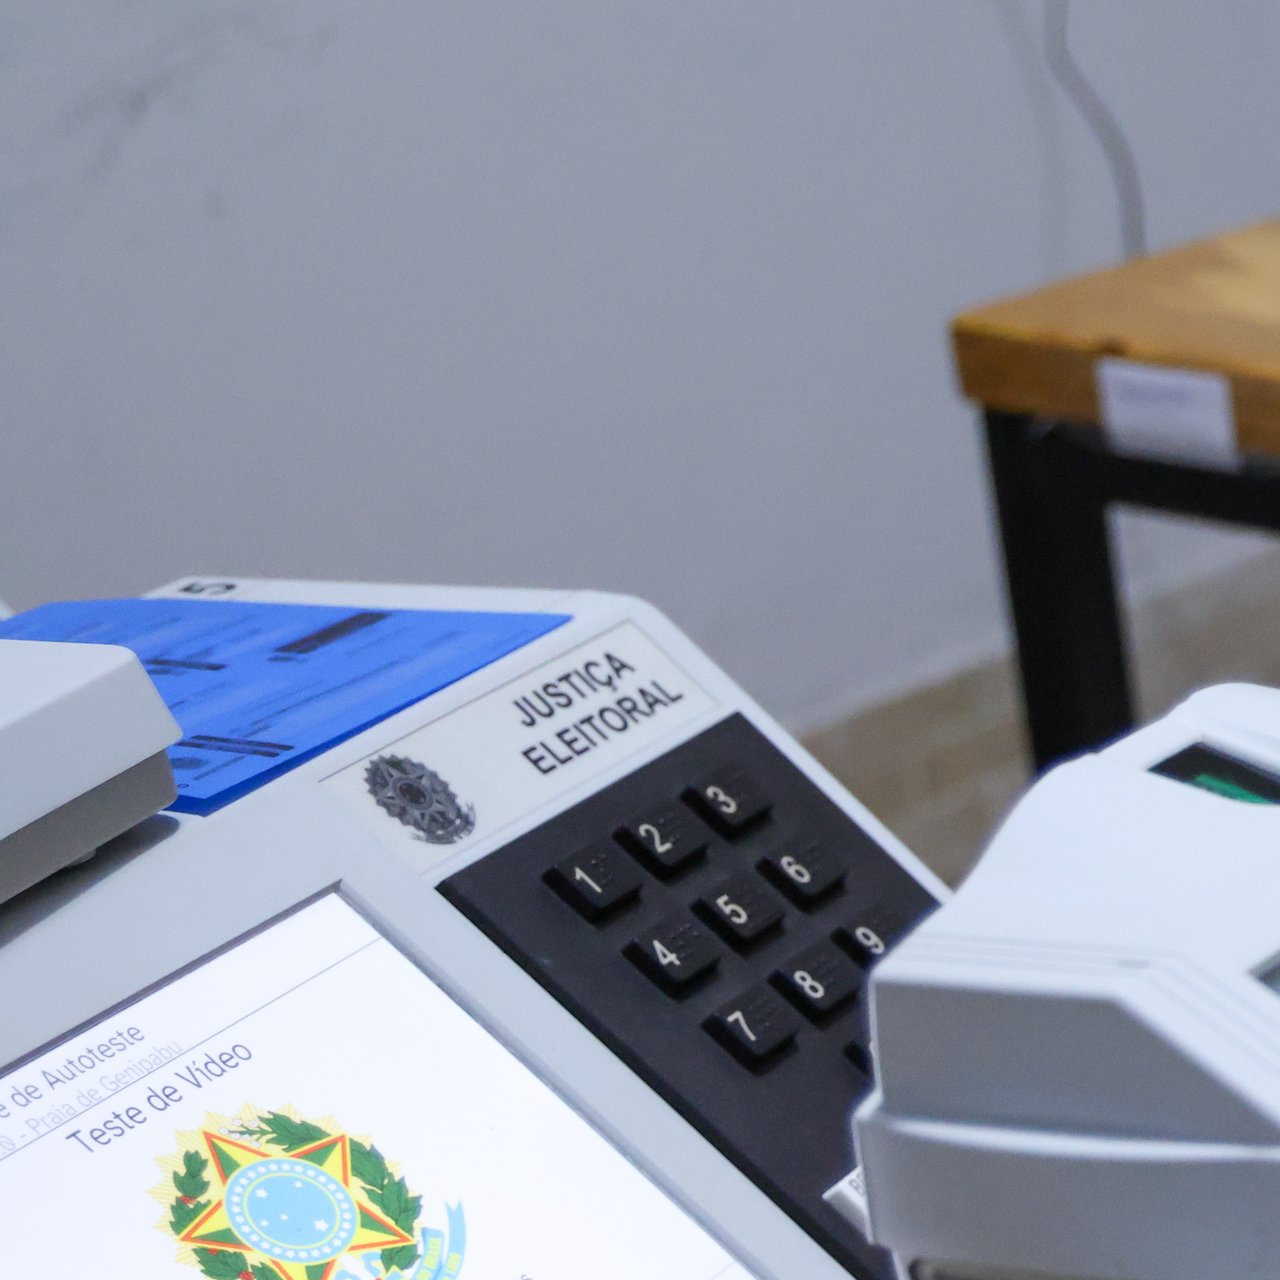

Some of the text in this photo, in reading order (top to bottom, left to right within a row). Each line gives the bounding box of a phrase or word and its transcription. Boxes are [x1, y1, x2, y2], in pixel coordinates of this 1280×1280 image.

[512, 652, 636, 728] JUSTIÇA
[521, 680, 684, 774] ELEITORAL
[706, 786, 738, 815] 3
[639, 824, 672, 854] 2
[574, 867, 603, 893] 1
[781, 856, 811, 884] 6
[716, 895, 748, 924] 5
[653, 940, 681, 966] 4
[856, 927, 885, 955] 9
[794, 970, 825, 999] 8
[728, 1010, 756, 1041] 7
[11, 1084, 43, 1108] de
[41, 1026, 145, 1090] Autoteste
[24, 1103, 78, 1136] Praia
[76, 1088, 102, 1109] de
[99, 1040, 184, 1093] Genipabu
[65, 1106, 147, 1153] Teste
[146, 1085, 183, 1111] de
[174, 1043, 253, 1089] Vídeo
